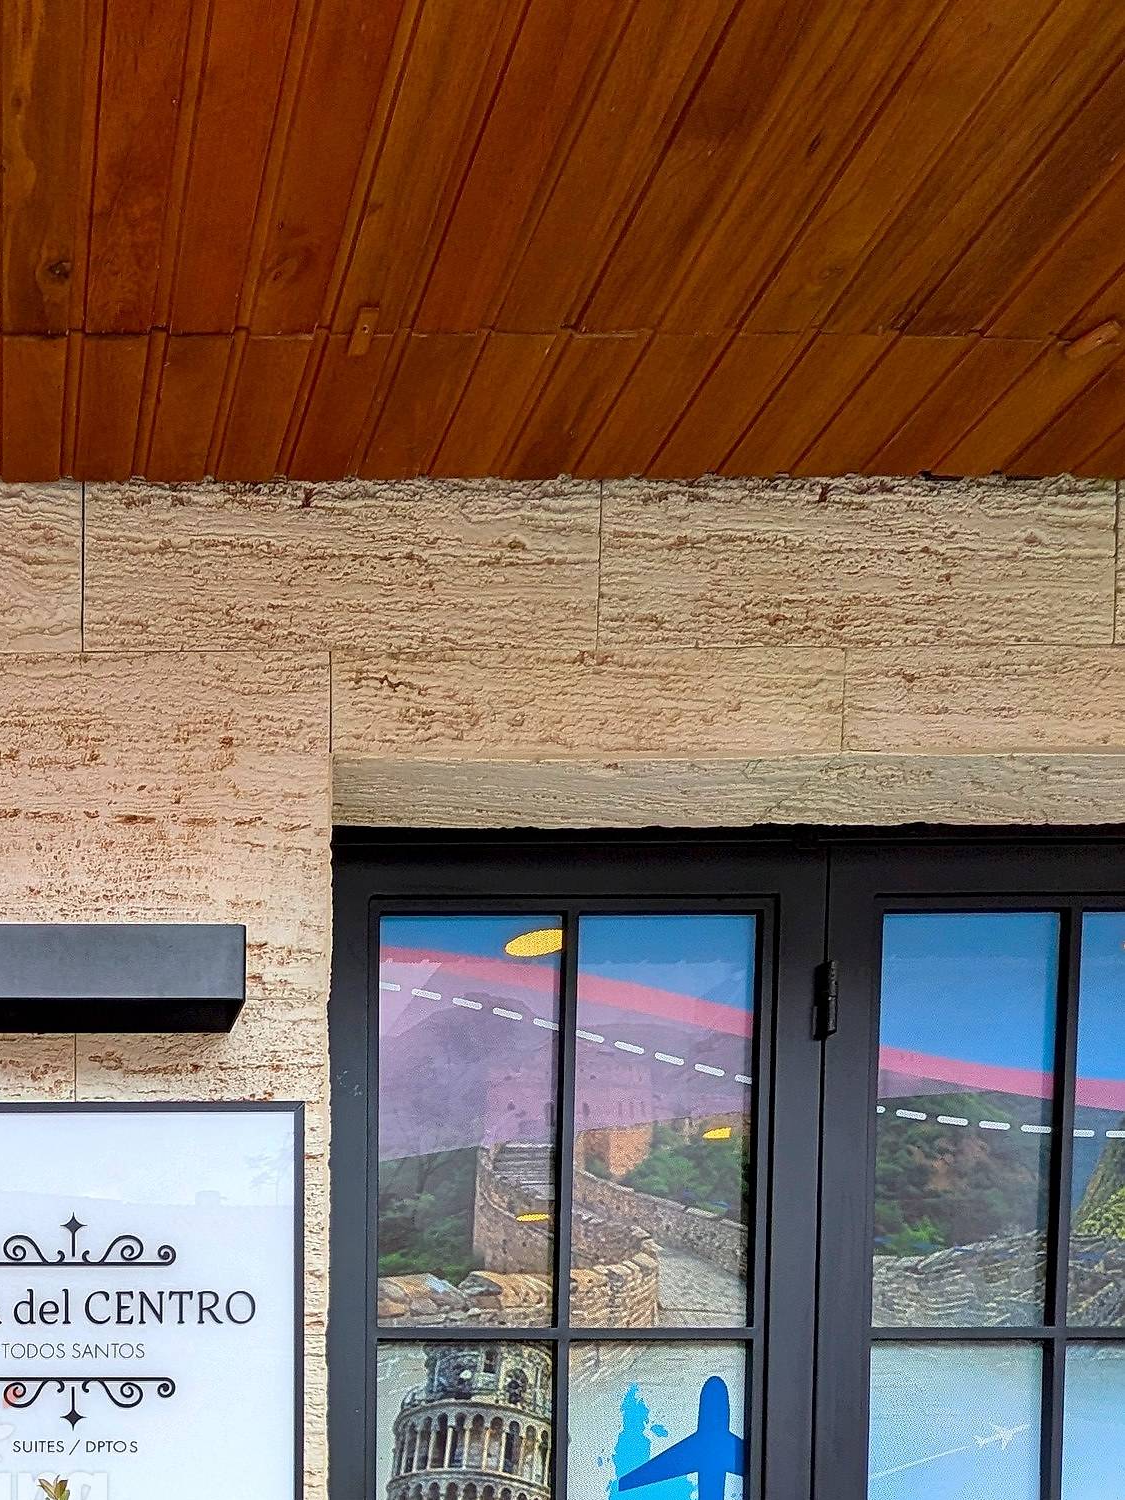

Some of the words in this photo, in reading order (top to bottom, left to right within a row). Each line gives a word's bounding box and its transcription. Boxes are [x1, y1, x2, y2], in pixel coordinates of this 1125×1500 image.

[13, 1288, 72, 1325] del
[84, 1290, 256, 1325] CENTRO
[1, 1342, 66, 1359] TODOS
[72, 1342, 145, 1359] SANTOS
[12, 1440, 65, 1453] SUITES
[85, 1440, 138, 1453] DPTOS
